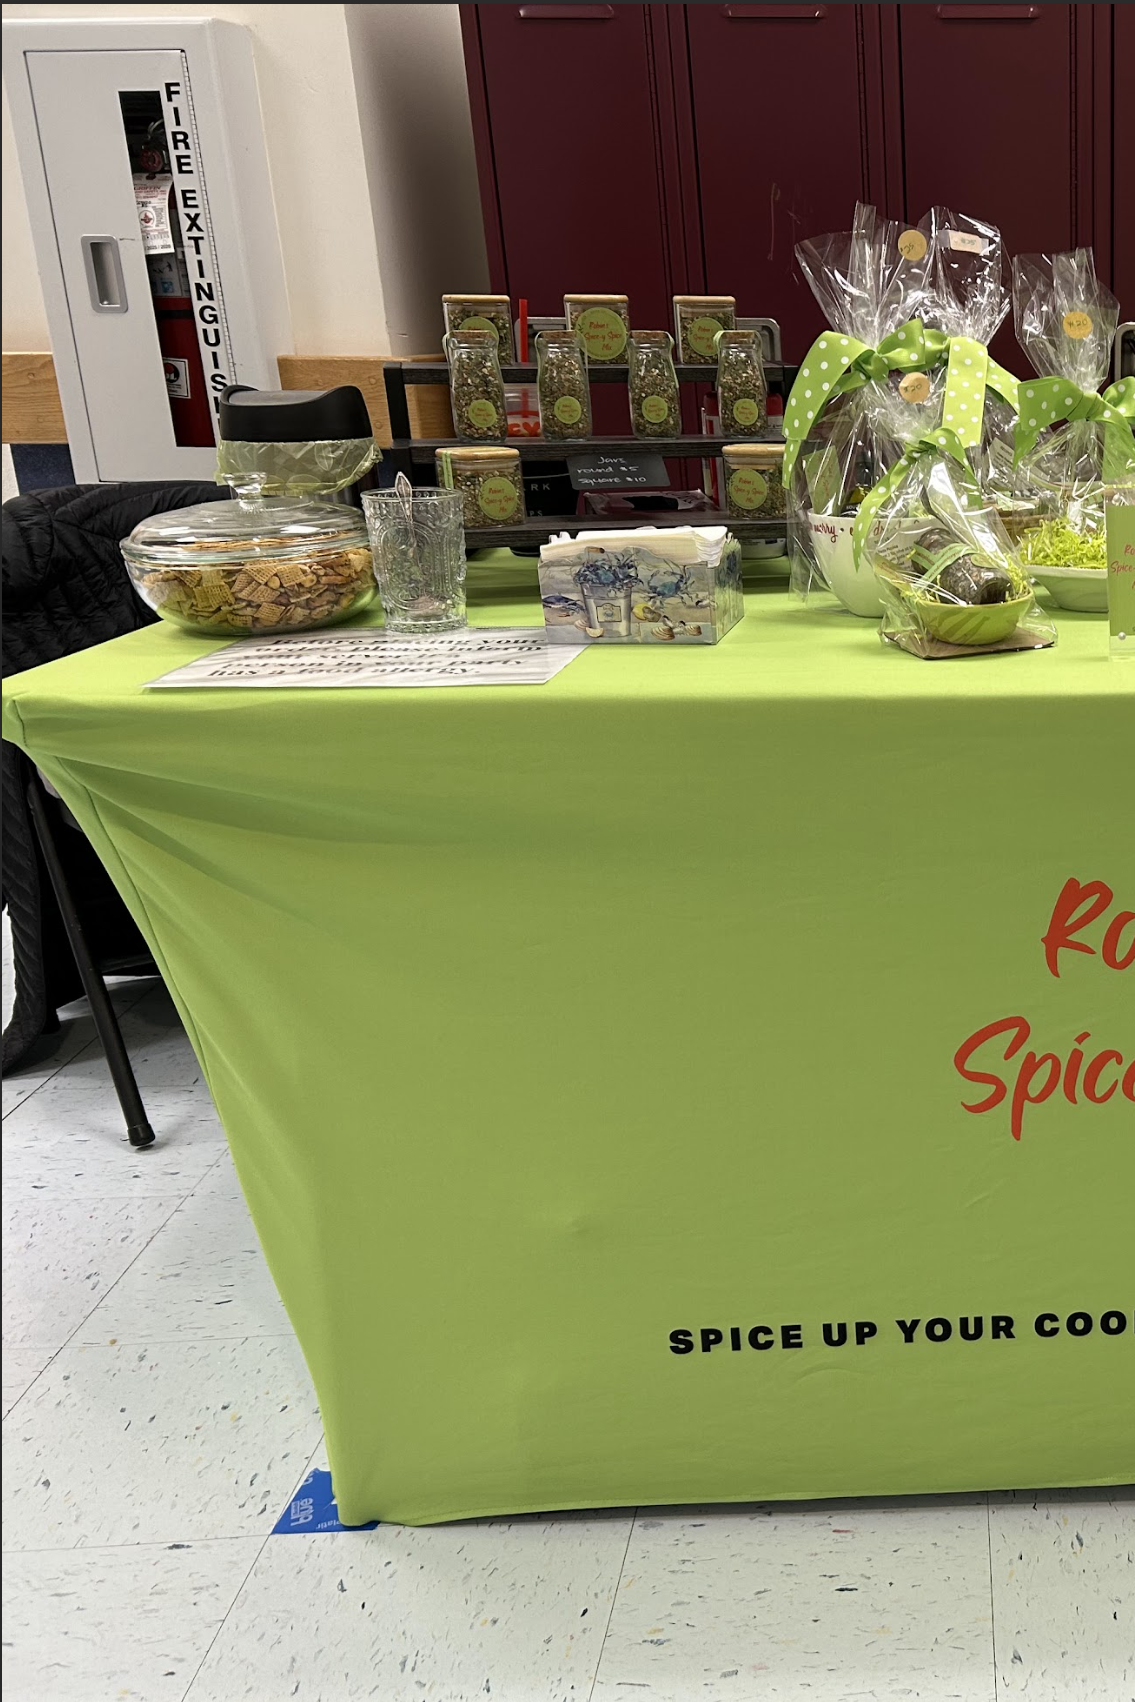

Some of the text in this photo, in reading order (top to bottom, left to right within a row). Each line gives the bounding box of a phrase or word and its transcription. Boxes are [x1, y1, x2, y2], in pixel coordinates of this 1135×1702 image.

[165, 82, 228, 428] FIRE EXTINGUIS
[578, 478, 621, 486] square
[222, 661, 324, 669] person
[447, 659, 528, 667] party
[668, 1324, 803, 1355] SPICE
[822, 1321, 878, 1347] UP
[896, 1315, 1017, 1344] YOUR
